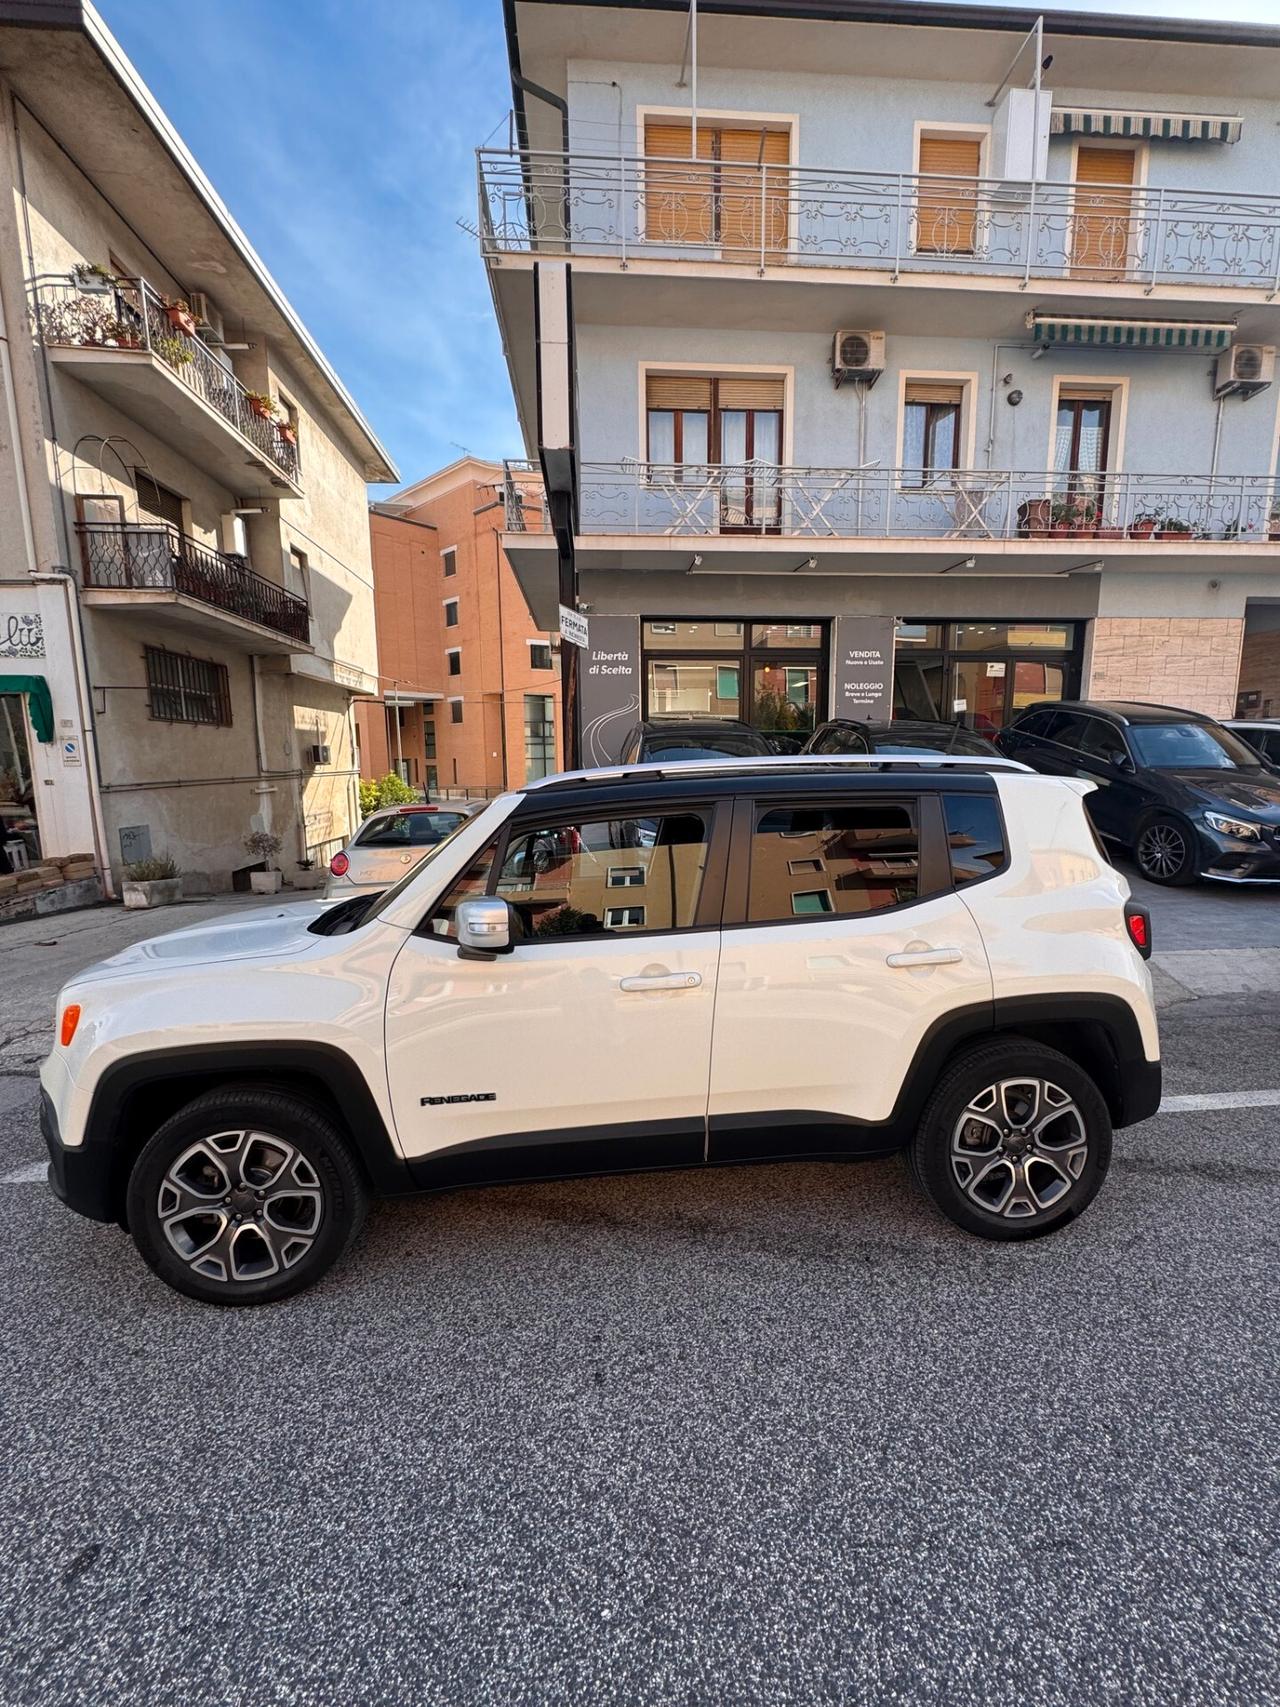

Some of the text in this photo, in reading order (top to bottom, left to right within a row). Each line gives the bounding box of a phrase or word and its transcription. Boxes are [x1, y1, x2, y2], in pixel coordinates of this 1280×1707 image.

[561, 615, 588, 636] FERMATA
[592, 650, 629, 661] Libertà
[849, 650, 881, 658] VENDITA
[589, 664, 633, 675] di Scelta
[844, 682, 884, 690] NOLEGGIO
[420, 1092, 497, 1106] RENEGADE
